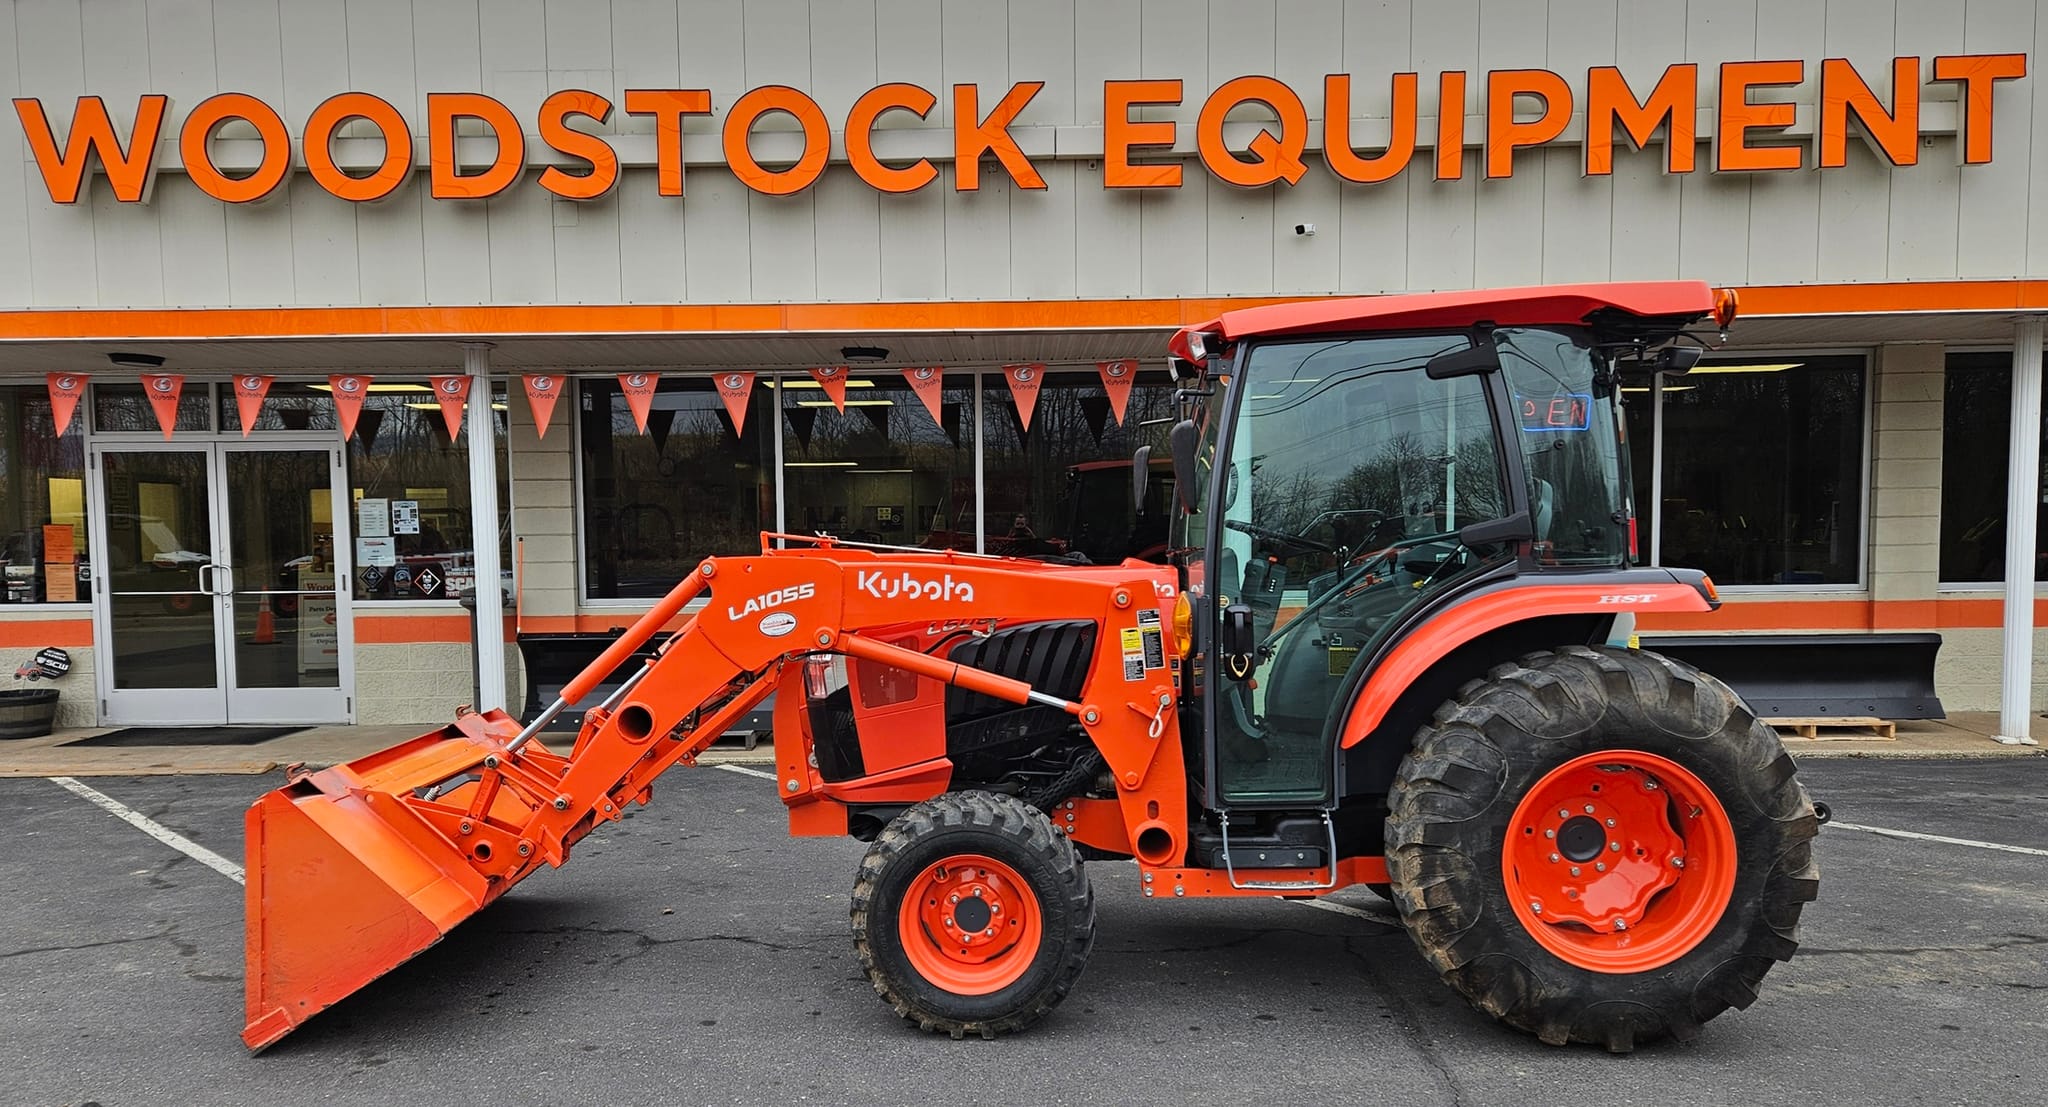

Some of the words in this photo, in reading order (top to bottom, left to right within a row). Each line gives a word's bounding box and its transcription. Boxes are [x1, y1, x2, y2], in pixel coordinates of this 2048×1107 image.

[11, 80, 1048, 205] WOODSTOCK
[1104, 53, 2027, 188] EQUIPMENT
[304, 583, 336, 591] Wood
[445, 577, 475, 591] SCA
[858, 570, 974, 602] Kubota
[728, 583, 815, 621] LA1055
[1597, 593, 1658, 604] HST
[45, 659, 69, 671] SCW
